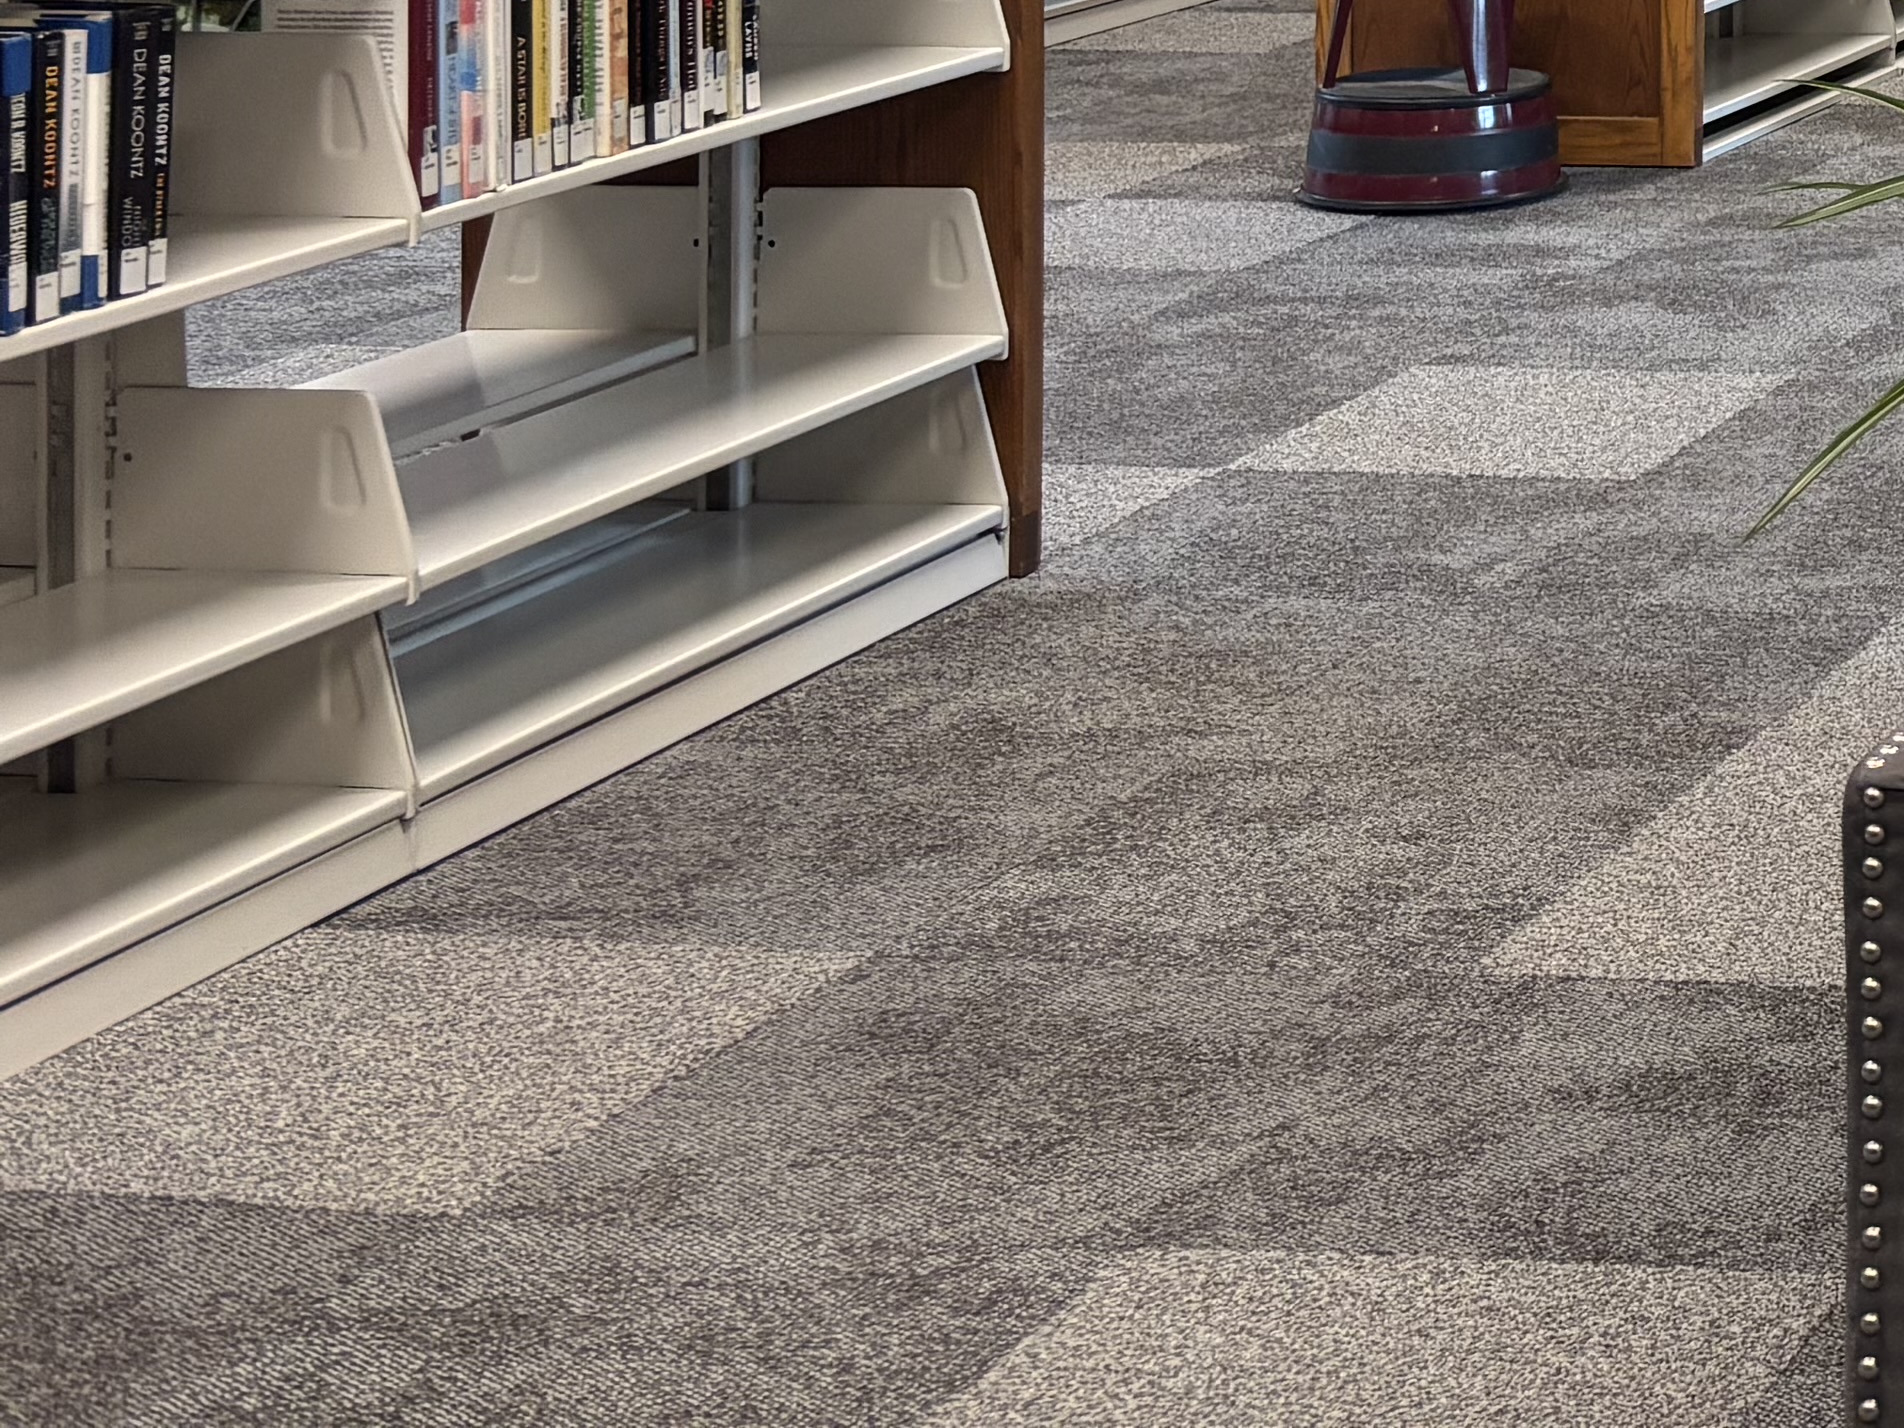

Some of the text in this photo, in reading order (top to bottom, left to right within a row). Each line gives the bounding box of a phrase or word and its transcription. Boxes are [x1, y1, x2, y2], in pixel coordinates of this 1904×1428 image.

[44, 65, 59, 189] DEAN KOONTZ
[69, 57, 81, 177] DEAN KOONTZ
[129, 48, 148, 179] DEAN KOONTZ
[156, 54, 172, 166] DEAN KOONTZ
[515, 36, 527, 100] A STAR IS
